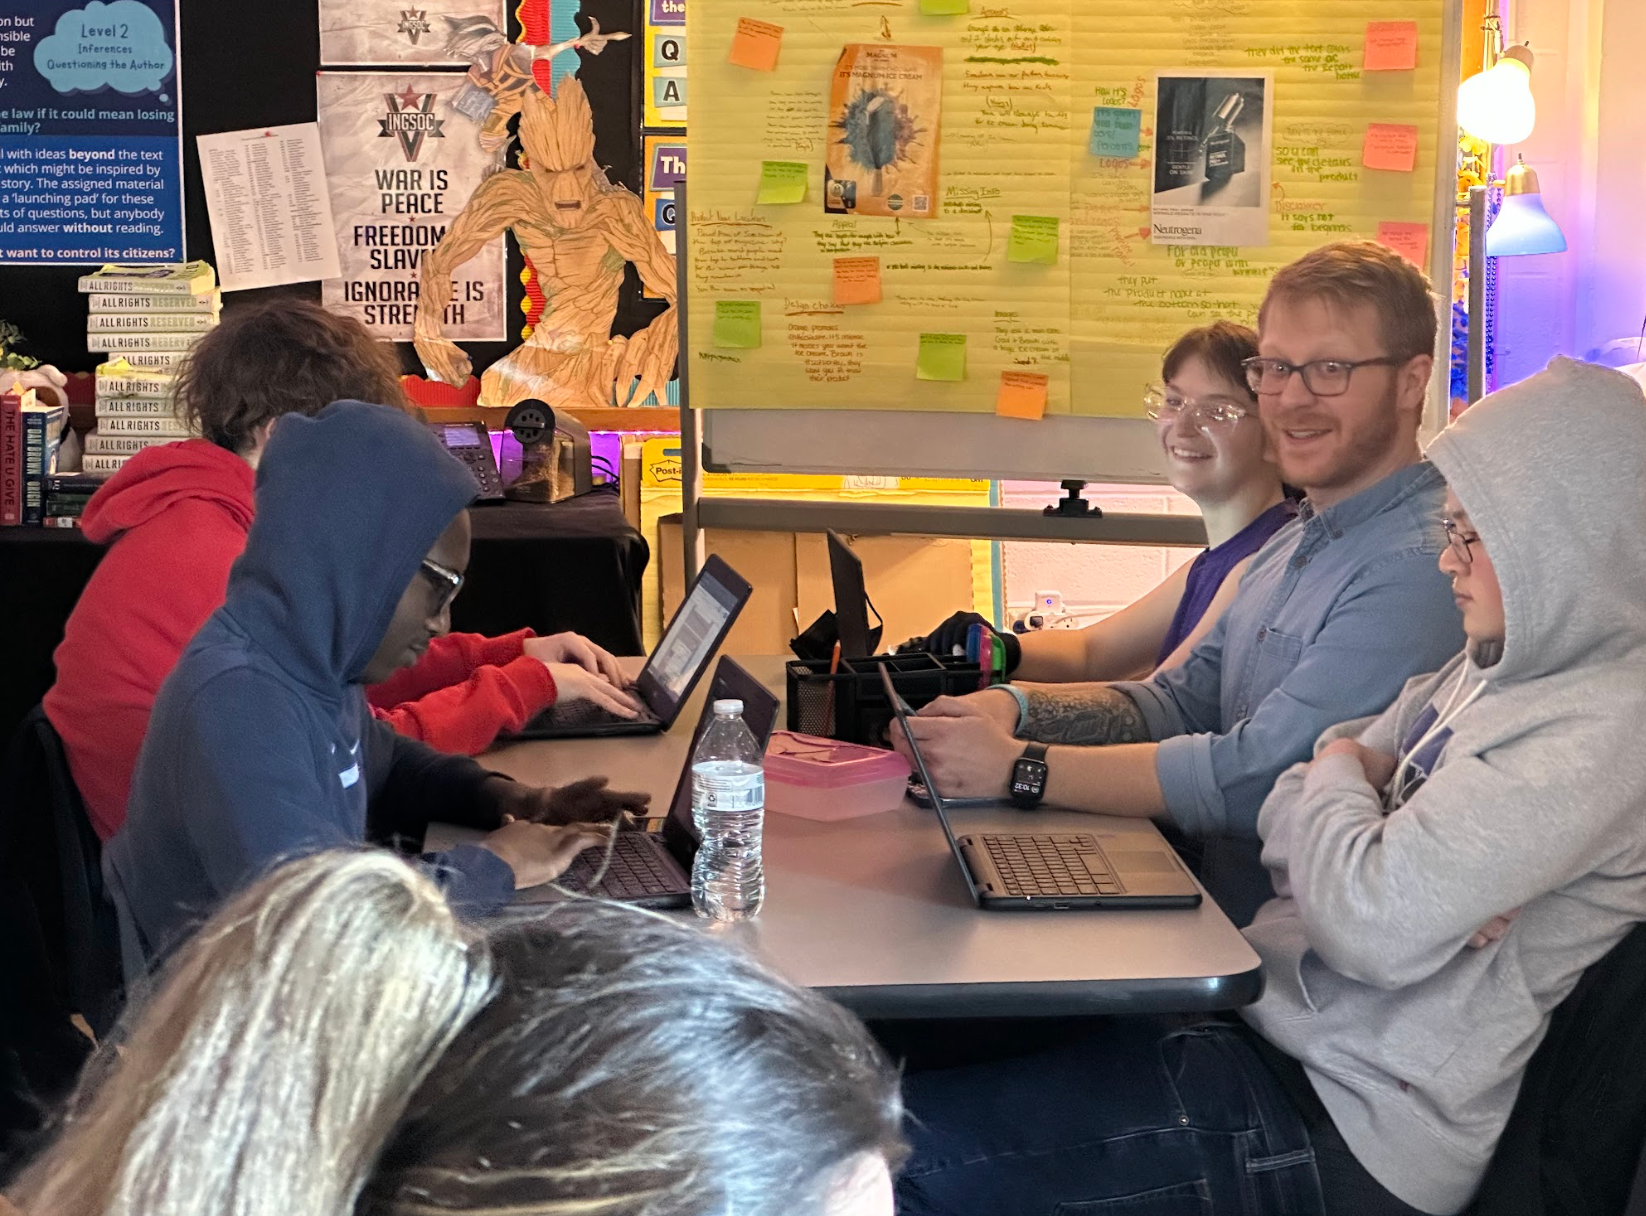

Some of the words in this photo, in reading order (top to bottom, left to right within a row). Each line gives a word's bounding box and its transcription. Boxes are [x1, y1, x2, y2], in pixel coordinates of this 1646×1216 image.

[662, 0, 686, 13] the
[14, 16, 34, 26] but
[402, 20, 426, 30] INGSOC
[82, 24, 116, 38] Level
[120, 24, 129, 38] 2
[0, 46, 16, 56] be
[78, 44, 132, 54] Inferences
[661, 39, 680, 61] Q
[47, 60, 106, 70] Questioning
[110, 60, 126, 70] the
[130, 60, 164, 70] Author
[662, 80, 680, 102] A
[12, 108, 34, 118] law
[38, 108, 46, 119] if
[49, 108, 58, 119] it
[62, 108, 96, 120] could
[99, 110, 134, 120] mean
[138, 109, 174, 122] losing
[388, 114, 435, 131] INGSOC
[6, 149, 32, 160] with
[36, 149, 66, 160] ideas
[69, 149, 116, 163] beyond
[118, 150, 138, 160] the
[141, 150, 164, 160] text
[4, 163, 38, 174] which
[42, 164, 74, 176] might
[78, 164, 93, 174] be
[96, 164, 144, 177] inspired
[146, 164, 160, 177] by
[1, 180, 34, 191] story.
[36, 178, 58, 189] The
[61, 178, 112, 192] assigned
[116, 179, 164, 190] material
[375, 170, 422, 190] WAR
[430, 170, 448, 190] IS
[2, 195, 9, 204] a
[102, 194, 118, 204] for
[122, 194, 154, 204] these
[382, 193, 444, 214] PEACE
[13, 207, 26, 218] of
[28, 208, 88, 220] questions,
[91, 208, 112, 218] but
[114, 208, 164, 222] anybody
[18, 224, 60, 233] answer
[63, 222, 113, 234] without
[116, 223, 164, 236] reading.
[354, 225, 446, 246] FREEDOM
[1154, 224, 1202, 236] Neutrogena
[6, 248, 38, 258] want
[41, 248, 54, 258] to
[57, 248, 100, 258] control
[104, 248, 120, 258] its
[122, 248, 175, 258] citizens?
[89, 282, 102, 291] ALL
[104, 281, 132, 292] RIGHTS
[344, 281, 458, 302] IGNORAE
[466, 281, 484, 302] IS
[102, 298, 116, 308] ALL
[118, 298, 150, 308] RIGHTS
[152, 298, 197, 308] RESERVED
[364, 304, 464, 324] STRETH
[100, 318, 114, 328] ALL
[116, 318, 148, 328] RIGHTS
[150, 318, 195, 328] RESERVED
[102, 338, 116, 348] ALL
[118, 338, 150, 348] RIGHTS
[138, 356, 170, 366] RIGHTS
[109, 382, 124, 392] ALL
[126, 382, 159, 392] RIGHTS
[109, 402, 124, 412] ALL
[126, 402, 158, 412] RIGHTS
[6, 410, 15, 430] THE
[110, 421, 125, 430] ALL
[127, 421, 160, 430] RIGHTS
[26, 428, 42, 444] DAN
[6, 436, 14, 464] HATE
[100, 441, 114, 450] ALL
[26, 446, 42, 474] BROWN
[95, 460, 110, 469] ALL
[5, 478, 14, 506] GIVE
[26, 481, 40, 507] ORIGIN
